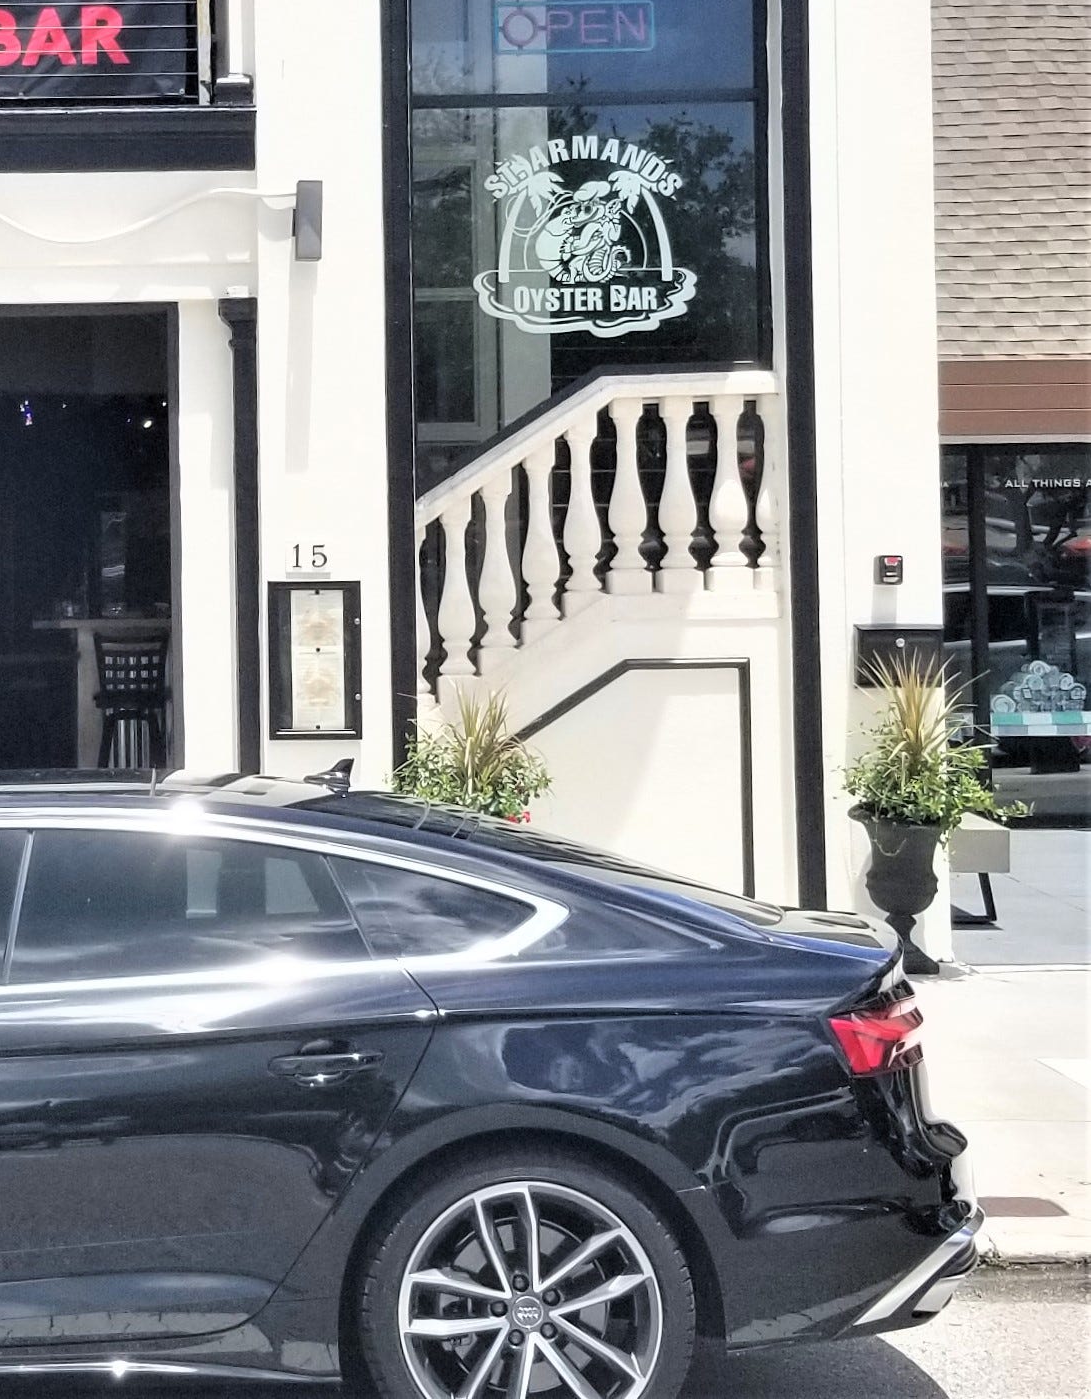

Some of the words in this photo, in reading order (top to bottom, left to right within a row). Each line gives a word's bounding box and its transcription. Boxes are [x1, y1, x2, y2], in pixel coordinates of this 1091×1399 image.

[502, 8, 648, 48] OPEN
[513, 285, 603, 314] OYSTER
[610, 285, 658, 313] BAR
[1004, 479, 1029, 488] ALL
[1032, 478, 1081, 488] THINGS
[292, 543, 328, 568] 15
